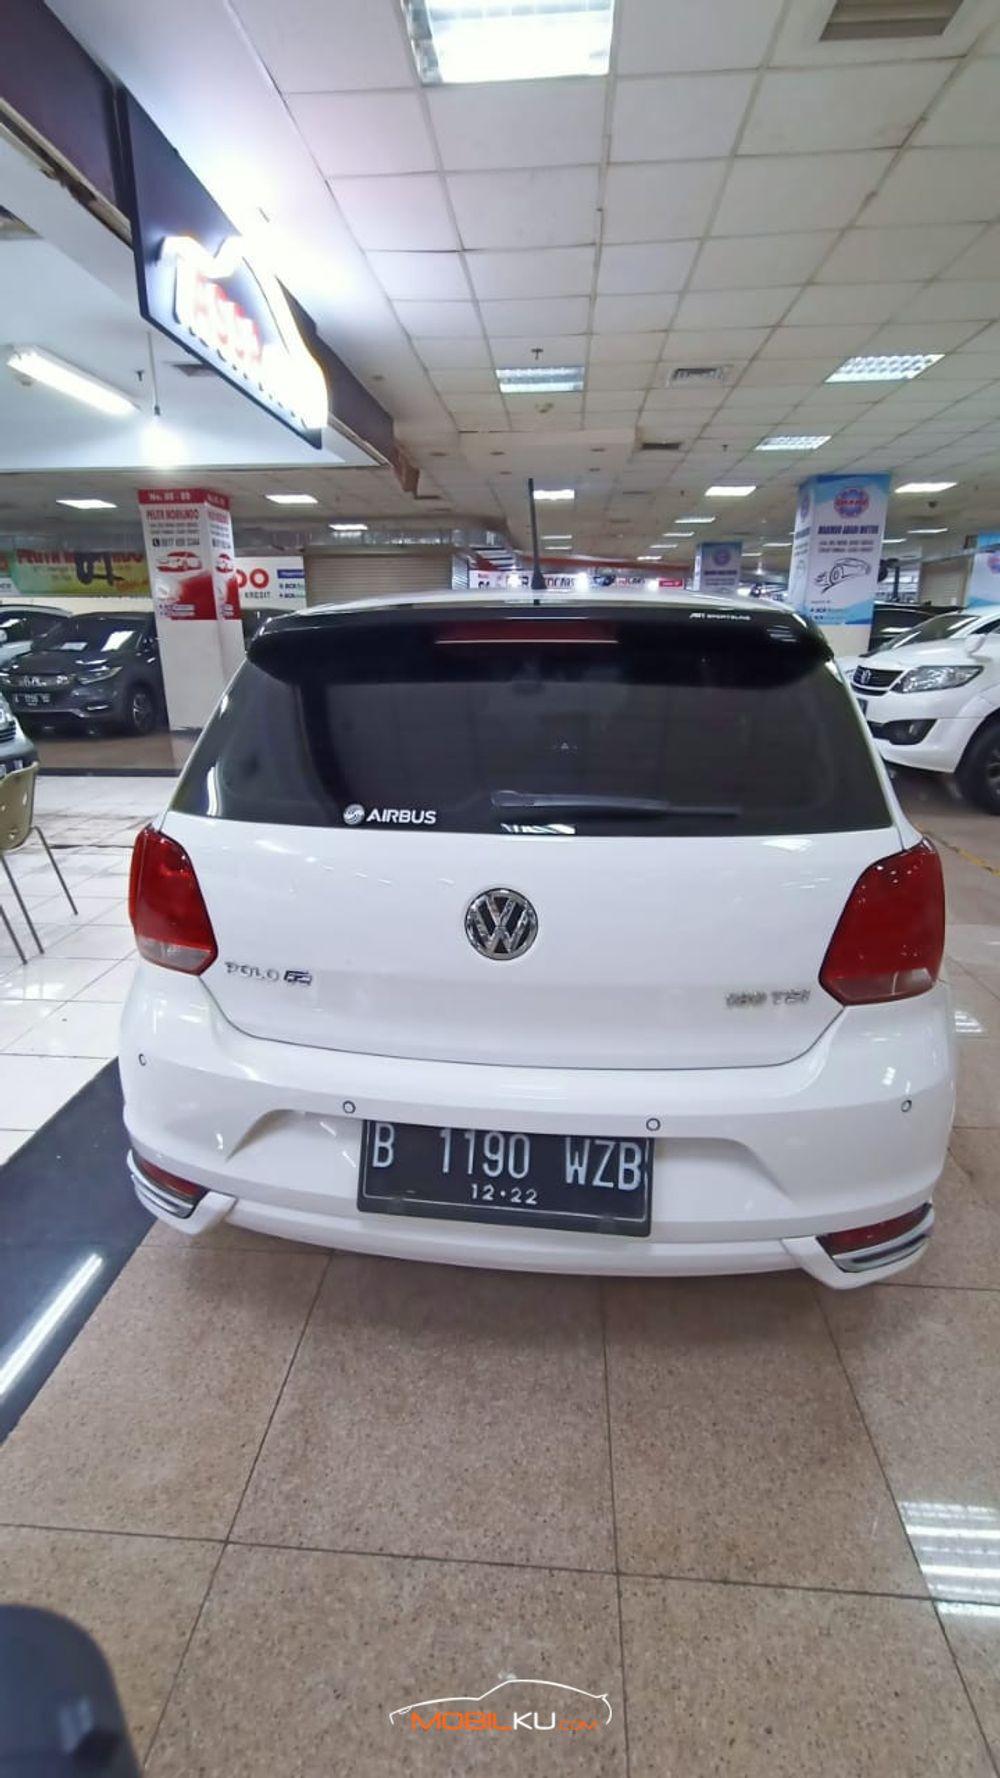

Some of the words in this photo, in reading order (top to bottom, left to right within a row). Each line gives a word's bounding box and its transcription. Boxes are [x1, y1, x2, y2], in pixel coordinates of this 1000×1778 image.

[366, 808, 438, 825] AIRBUS
[225, 962, 280, 982] POLO
[771, 989, 811, 1006] TSI
[372, 1121, 396, 1169] B
[439, 1127, 532, 1180] 1190
[564, 1136, 643, 1191] WZB
